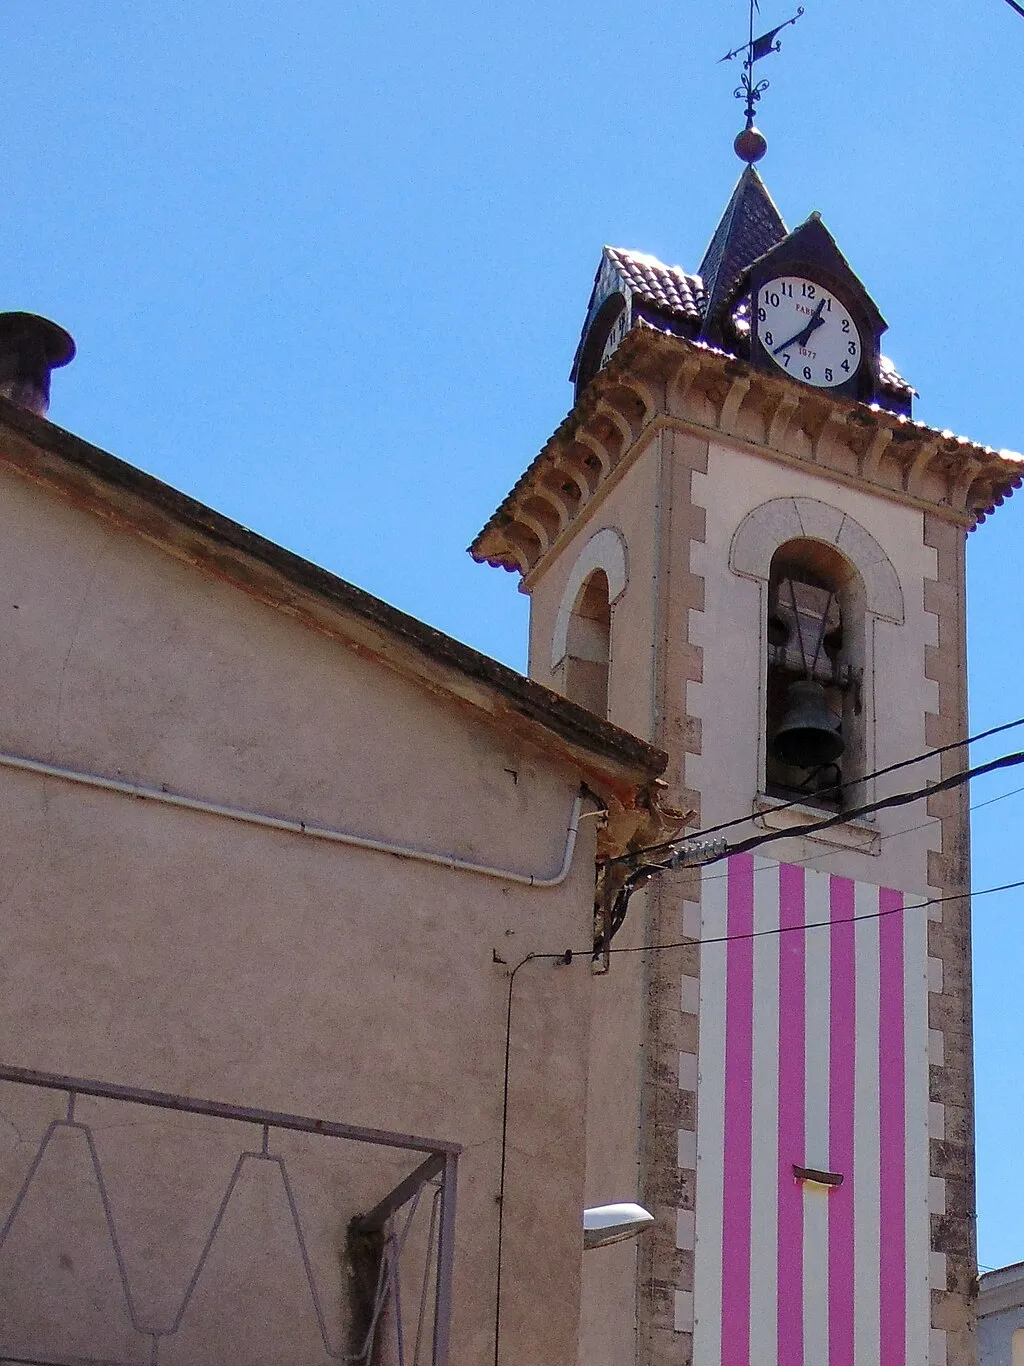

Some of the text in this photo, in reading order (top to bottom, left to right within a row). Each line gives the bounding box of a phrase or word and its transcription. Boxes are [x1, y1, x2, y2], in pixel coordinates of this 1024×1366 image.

[781, 282, 793, 298] 11
[801, 283, 816, 299] 12
[764, 291, 780, 307] 10
[826, 298, 832, 312] 1
[758, 308, 767, 322] 9
[841, 319, 850, 333] 2
[765, 331, 774, 346] 8
[848, 341, 857, 356] 3
[782, 354, 791, 367] 7
[841, 359, 850, 373] 4
[803, 366, 812, 380] 6
[825, 368, 833, 382] 5
